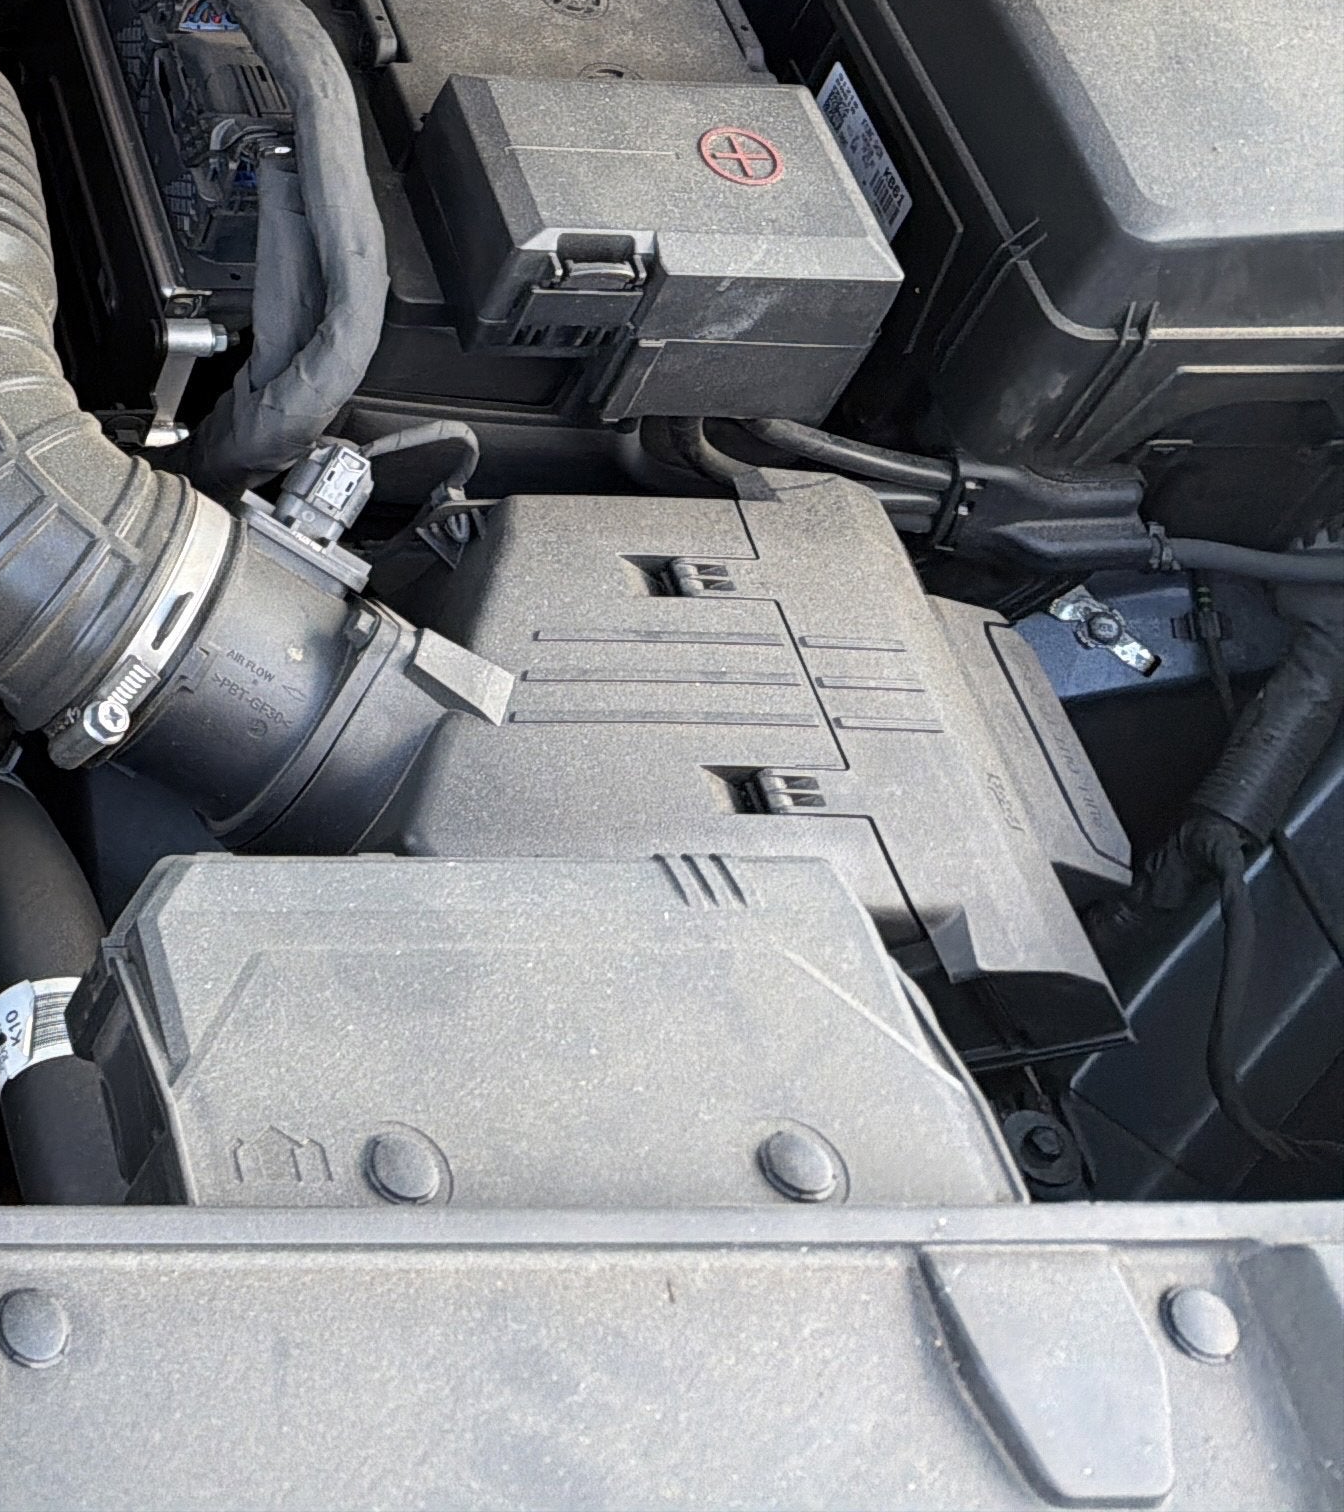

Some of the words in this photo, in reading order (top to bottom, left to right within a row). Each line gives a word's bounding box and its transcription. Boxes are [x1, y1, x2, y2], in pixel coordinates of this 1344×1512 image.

[227, 648, 251, 668] AIR
[244, 658, 277, 683] FLOW
[0, 1009, 21, 1049] K10
